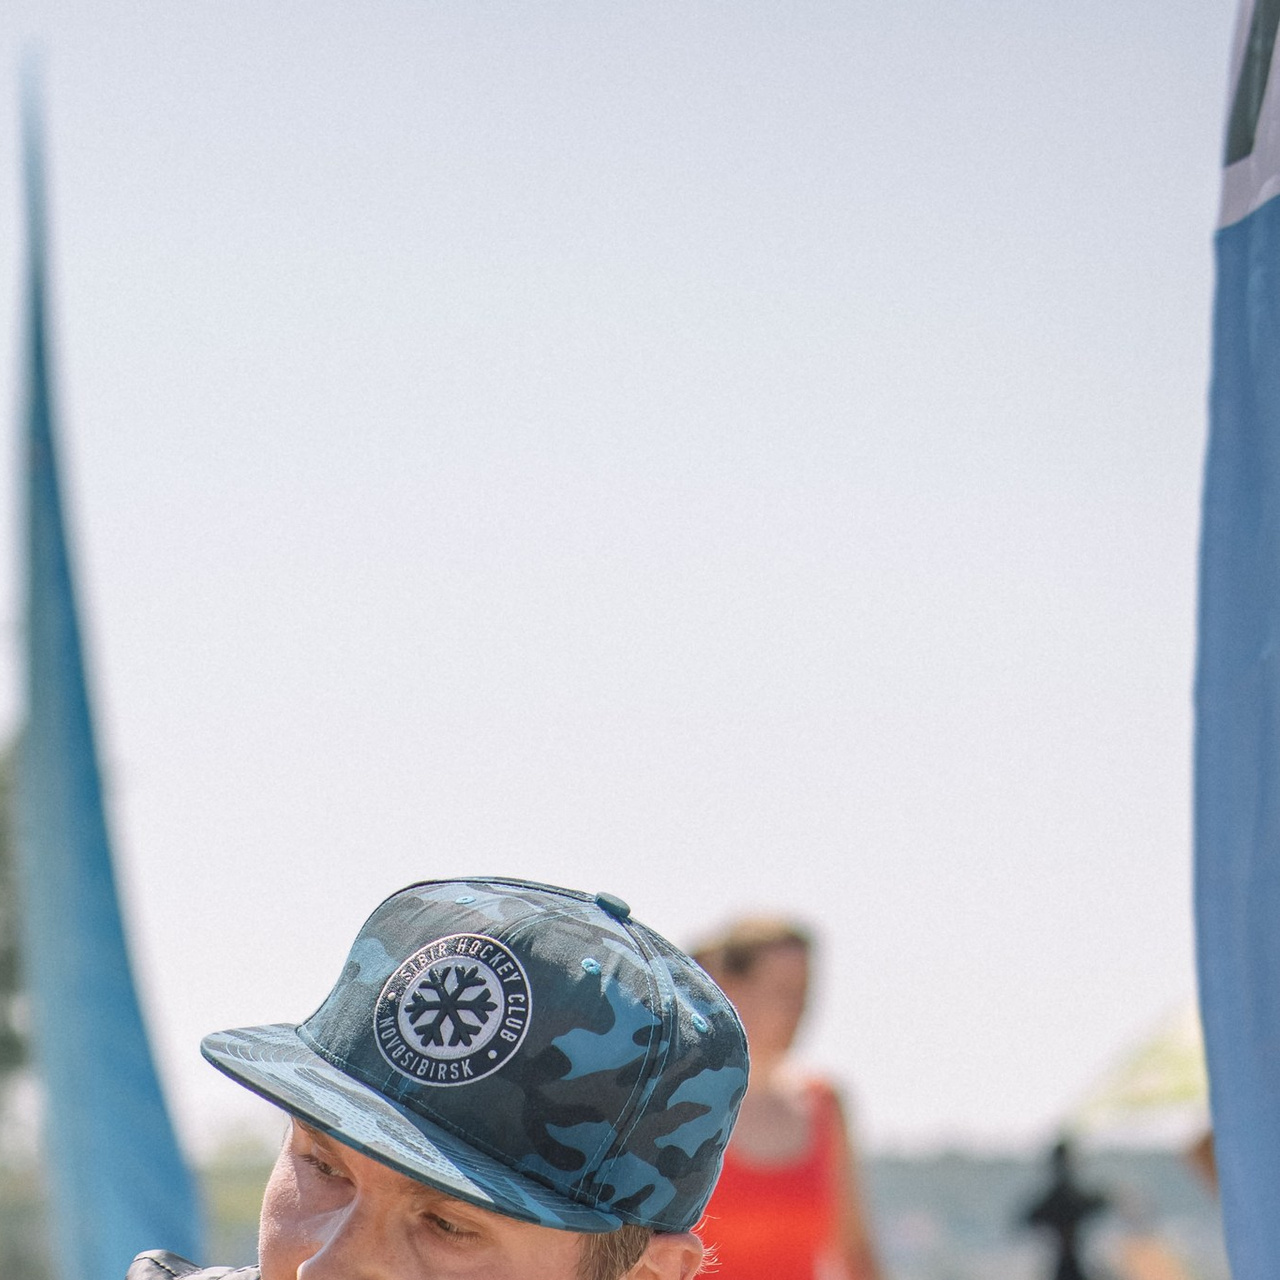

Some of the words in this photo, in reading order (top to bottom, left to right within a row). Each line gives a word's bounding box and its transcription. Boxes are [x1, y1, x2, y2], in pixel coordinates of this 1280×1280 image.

[401, 944, 447, 981] SIBIR
[456, 938, 522, 983] HOCKEY
[500, 993, 526, 1043] CLUB
[379, 1016, 474, 1080] NOVOSIBIRSK
